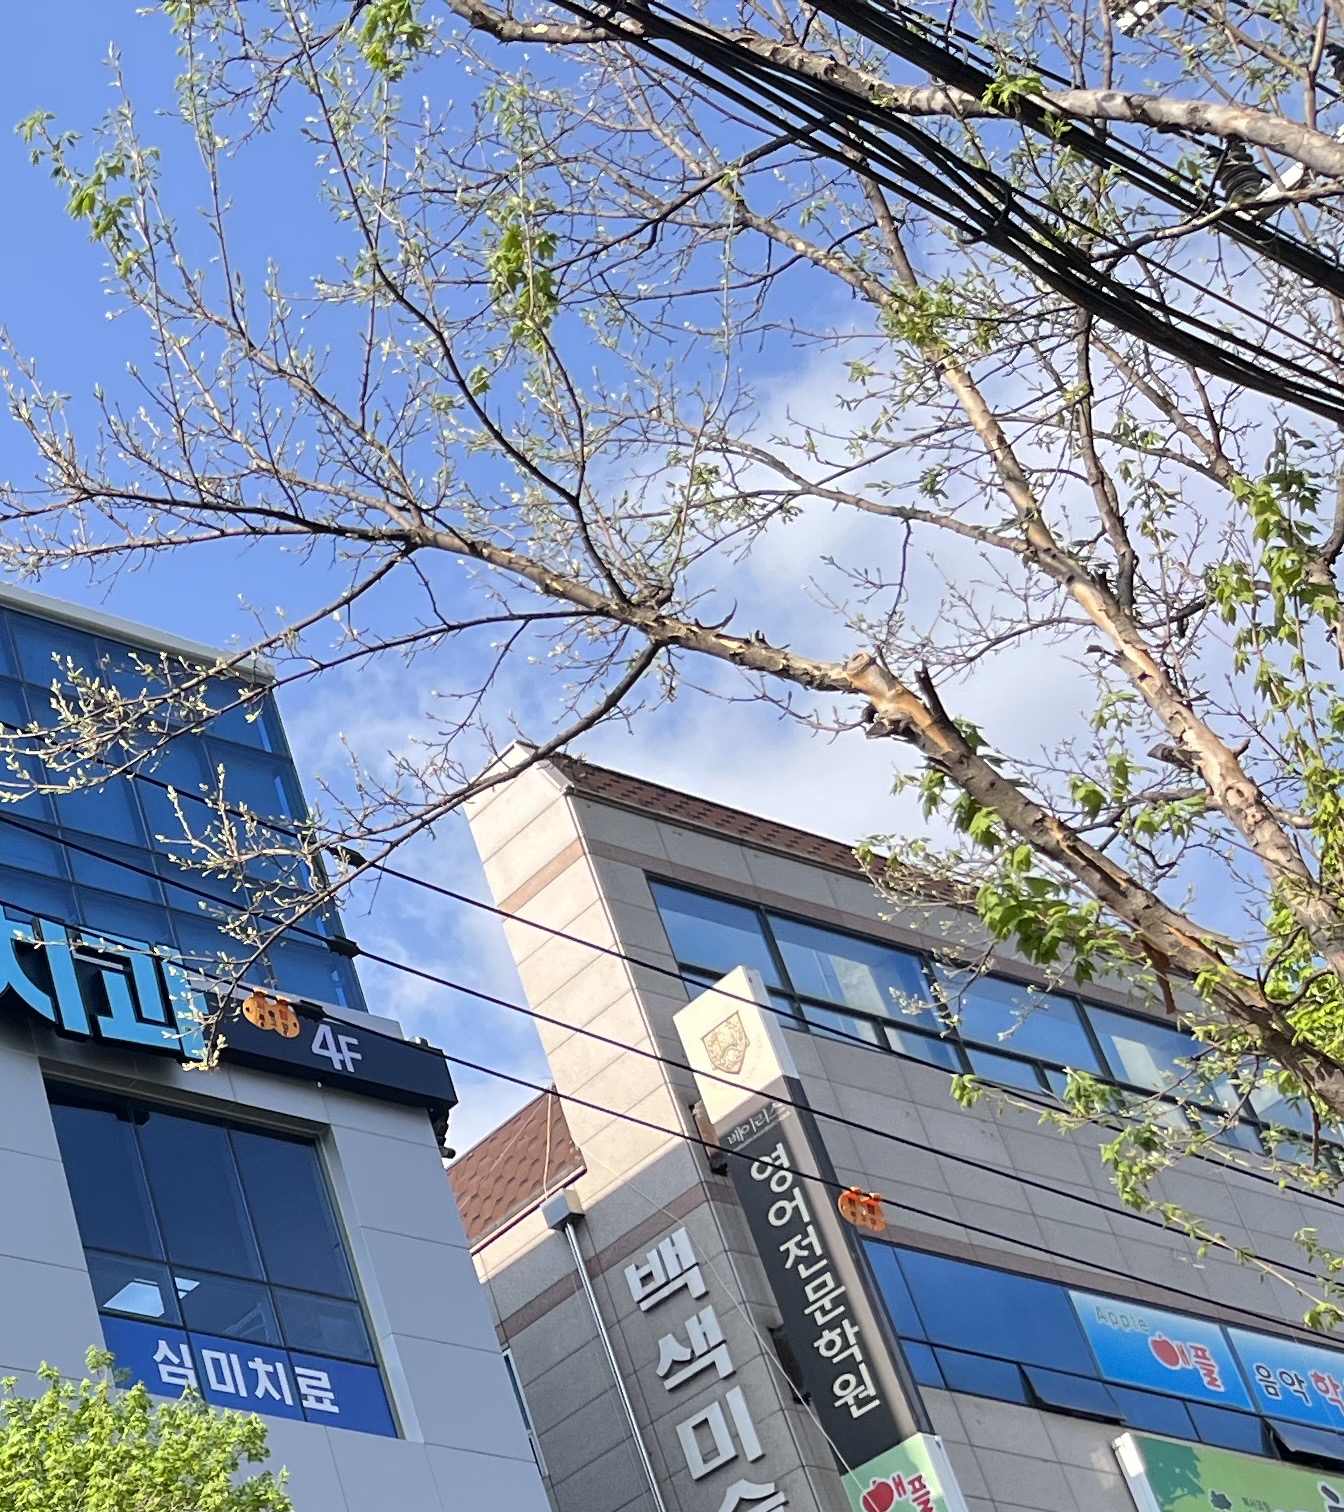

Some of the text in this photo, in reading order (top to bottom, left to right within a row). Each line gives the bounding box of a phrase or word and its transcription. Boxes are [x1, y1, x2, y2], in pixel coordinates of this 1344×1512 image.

[312, 1023, 363, 1073] 4F
[1095, 1306, 1150, 1333] Apple
[152, 1339, 340, 1414] 심미치료
